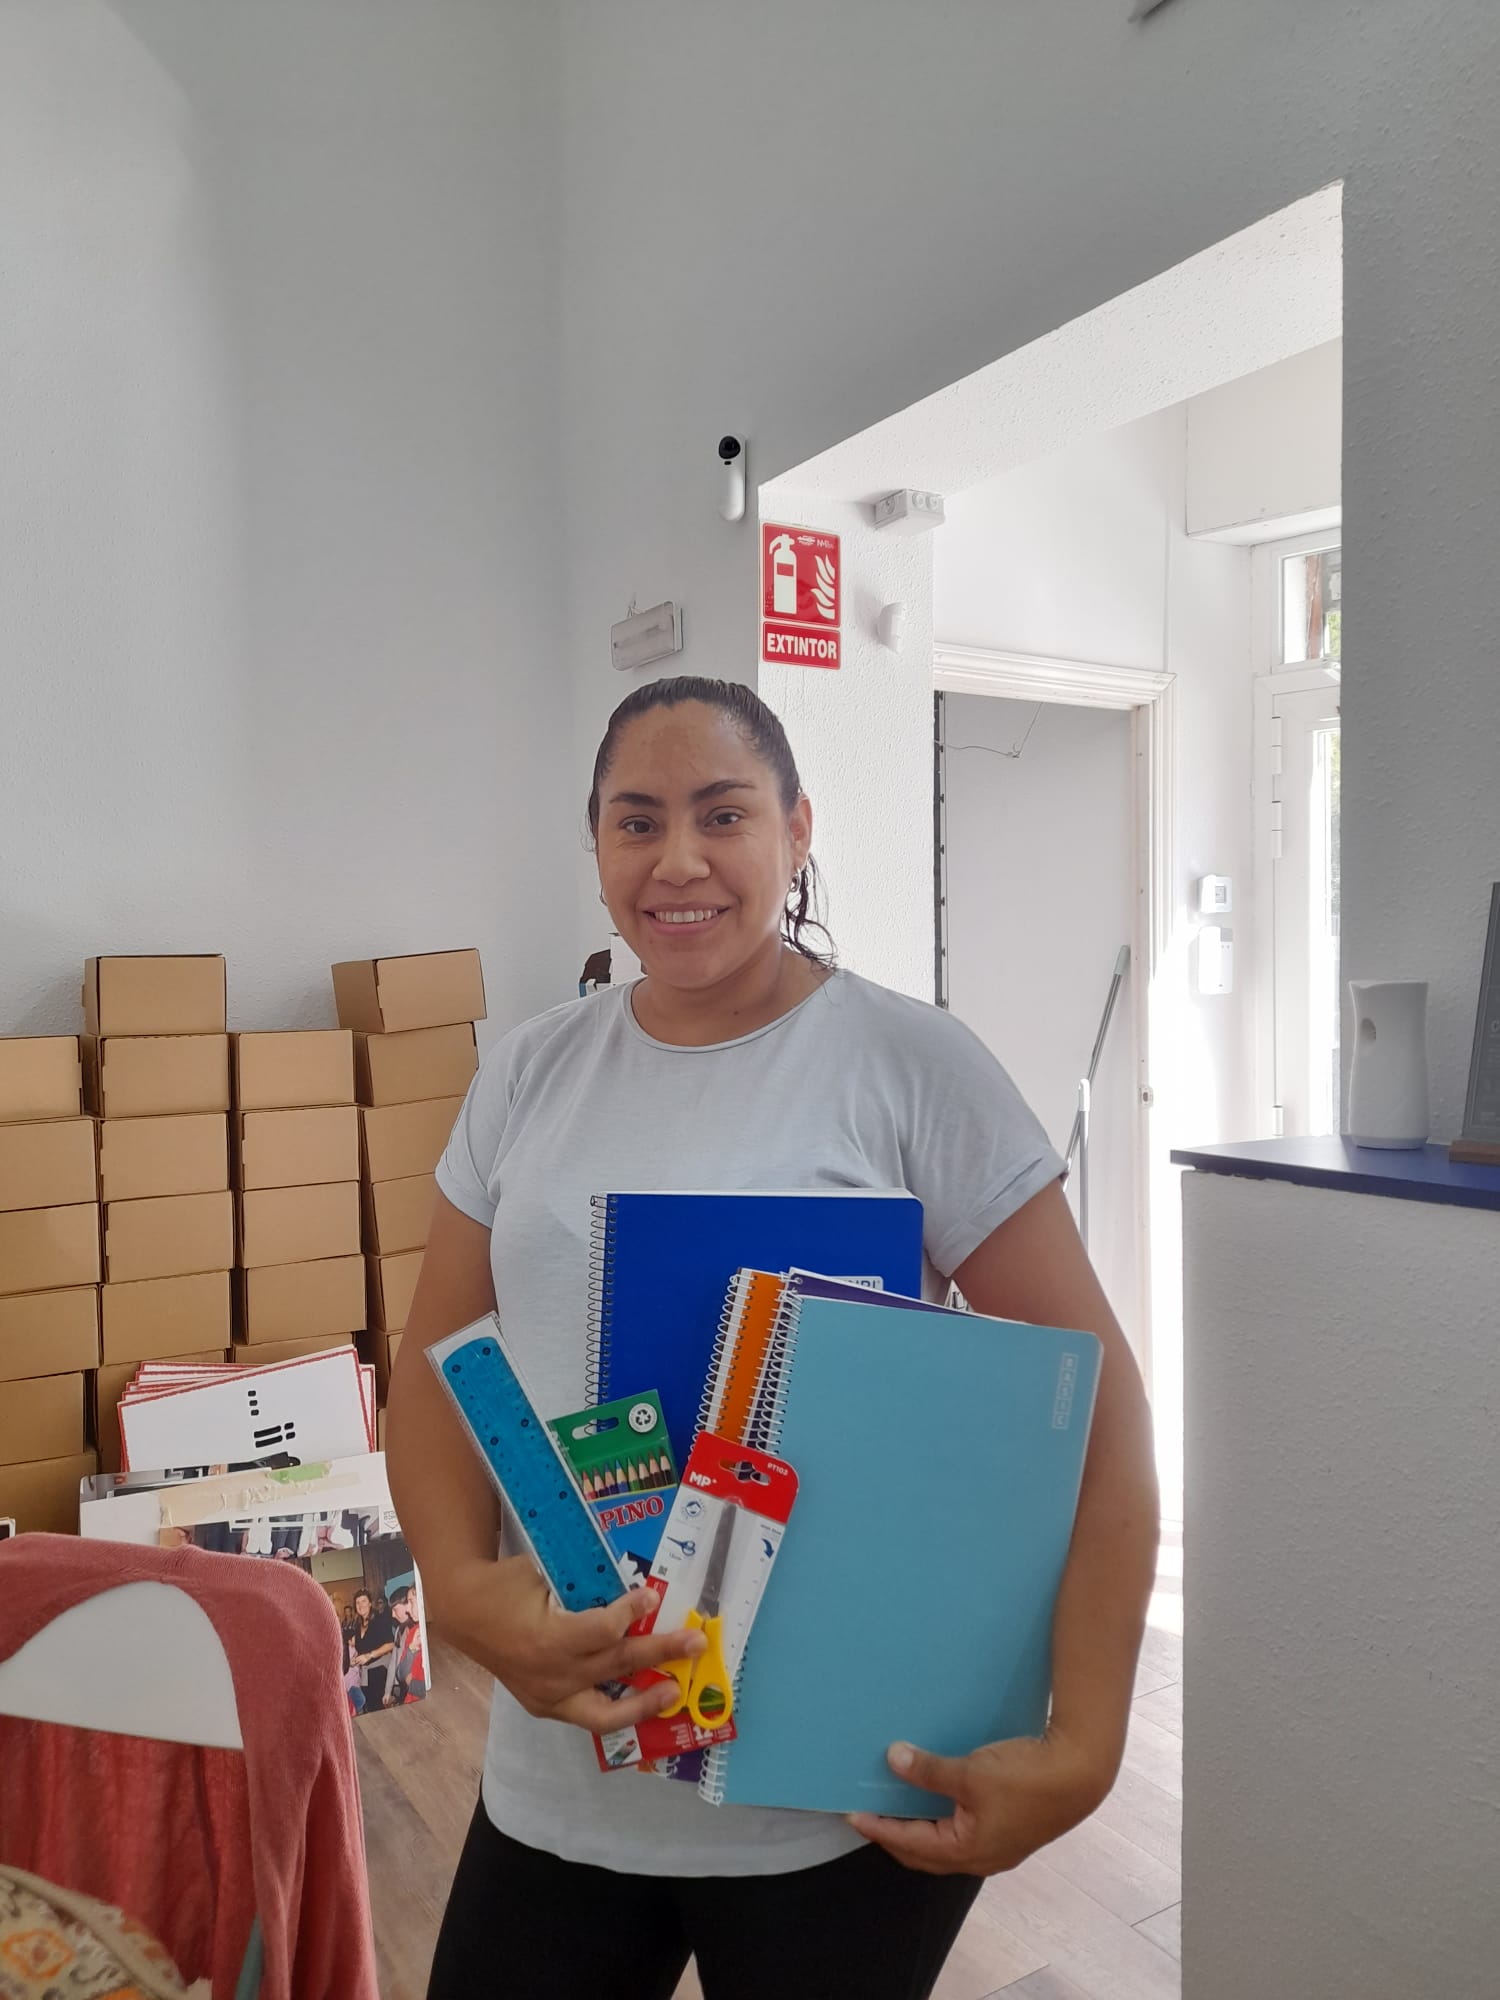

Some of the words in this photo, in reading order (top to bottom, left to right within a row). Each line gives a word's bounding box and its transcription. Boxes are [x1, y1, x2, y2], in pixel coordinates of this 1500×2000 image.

[767, 633, 837, 659] EXTINTOR
[689, 1471, 712, 1487] MP
[597, 1495, 665, 1531] PINO
